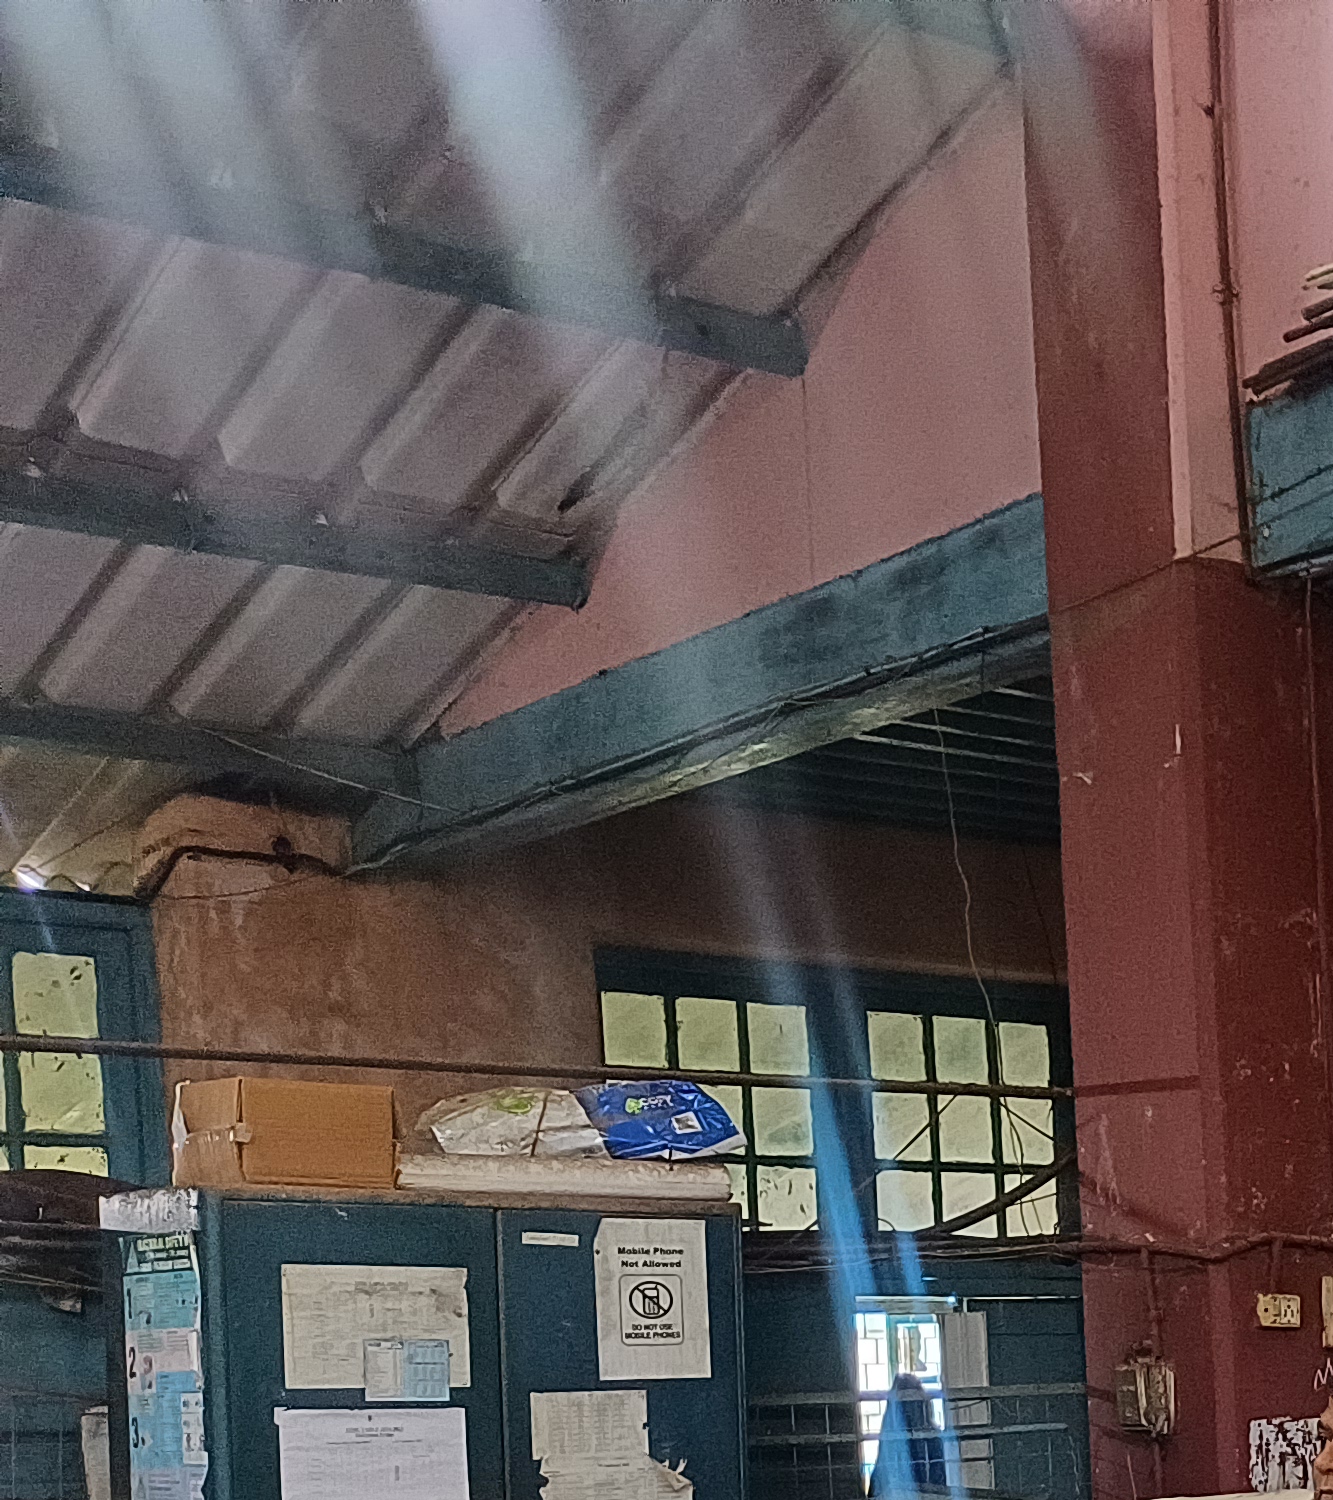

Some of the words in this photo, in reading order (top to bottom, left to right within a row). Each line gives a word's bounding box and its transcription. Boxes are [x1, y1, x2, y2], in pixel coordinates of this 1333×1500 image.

[618, 1246, 650, 1255] Mobile
[653, 1246, 684, 1255] Phone
[621, 1260, 638, 1268] Not
[642, 1260, 681, 1268] Allowed
[625, 1332, 652, 1340] MOBILE
[653, 1331, 681, 1339] PHONES
